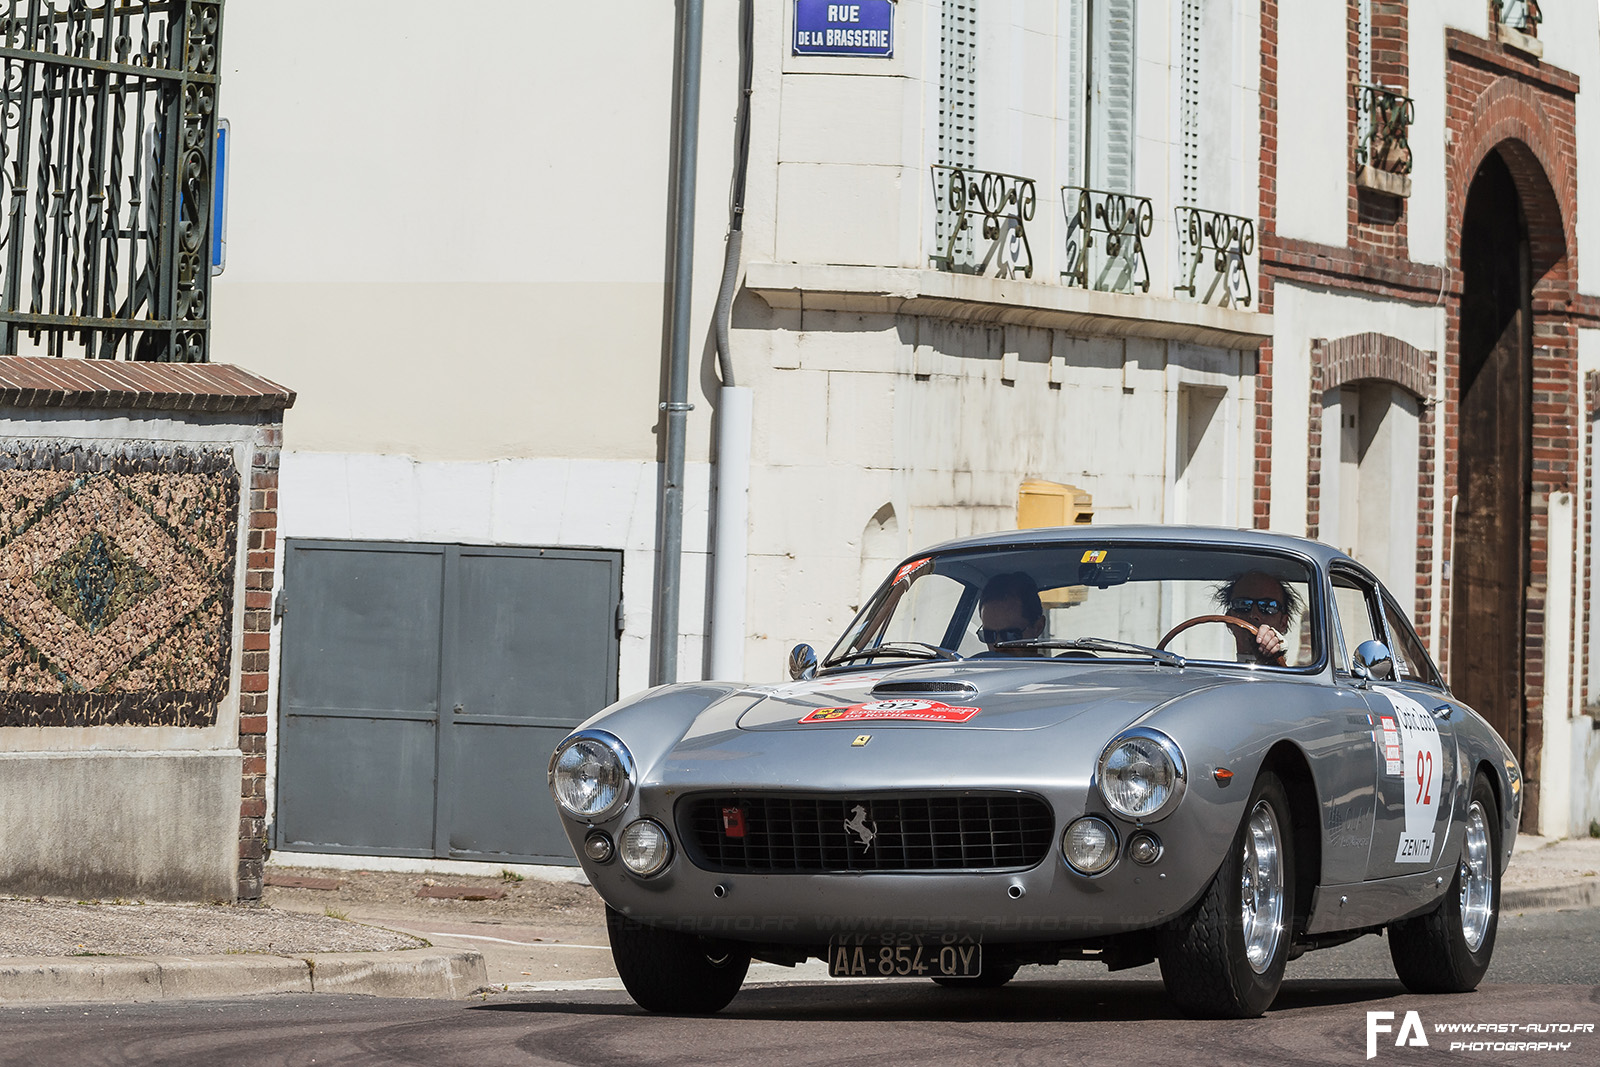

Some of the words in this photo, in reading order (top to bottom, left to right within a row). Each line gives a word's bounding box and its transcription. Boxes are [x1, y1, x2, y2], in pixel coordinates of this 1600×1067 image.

[828, 5, 859, 22] RUE
[798, 31, 810, 45] DE
[812, 31, 823, 46] LA
[826, 29, 888, 47] BRASSERIE
[1416, 750, 1432, 805] 92
[1401, 839, 1430, 856] ZENITH
[834, 946, 975, 975] AA-854-QY
